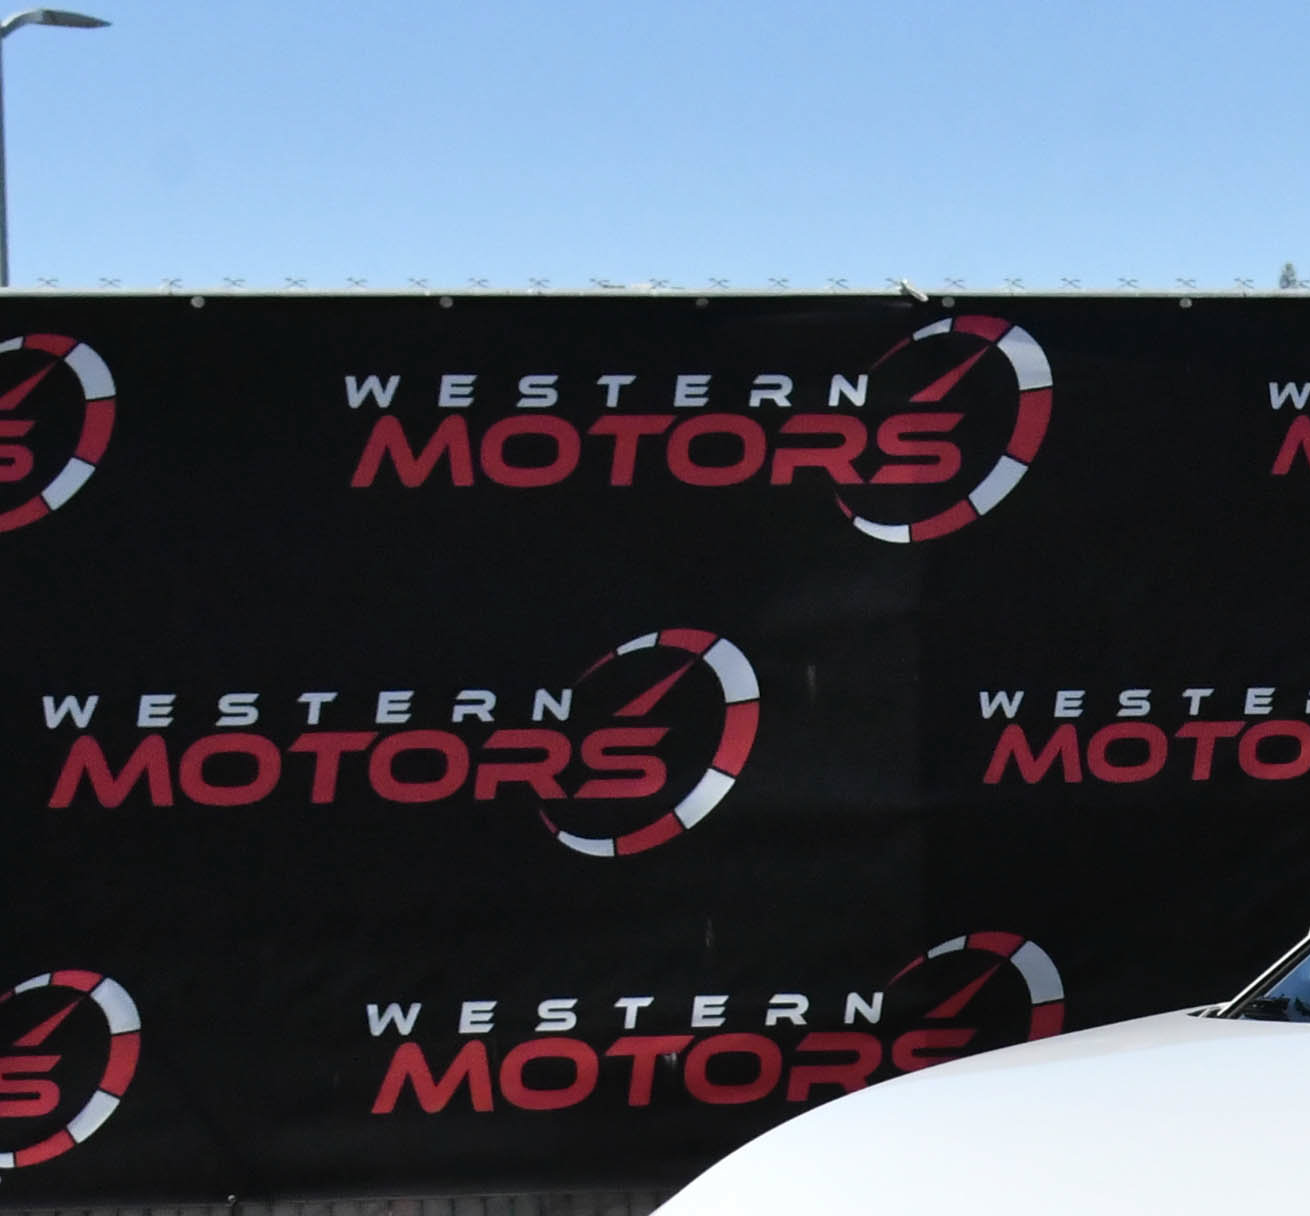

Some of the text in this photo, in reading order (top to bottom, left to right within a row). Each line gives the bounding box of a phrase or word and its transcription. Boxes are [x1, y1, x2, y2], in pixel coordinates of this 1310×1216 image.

[345, 374, 868, 408] WESTERN
[352, 413, 962, 487] MOTORS
[43, 689, 572, 728] WESTERN
[49, 728, 668, 808] MOTORS
[367, 992, 884, 1036] WESTERN
